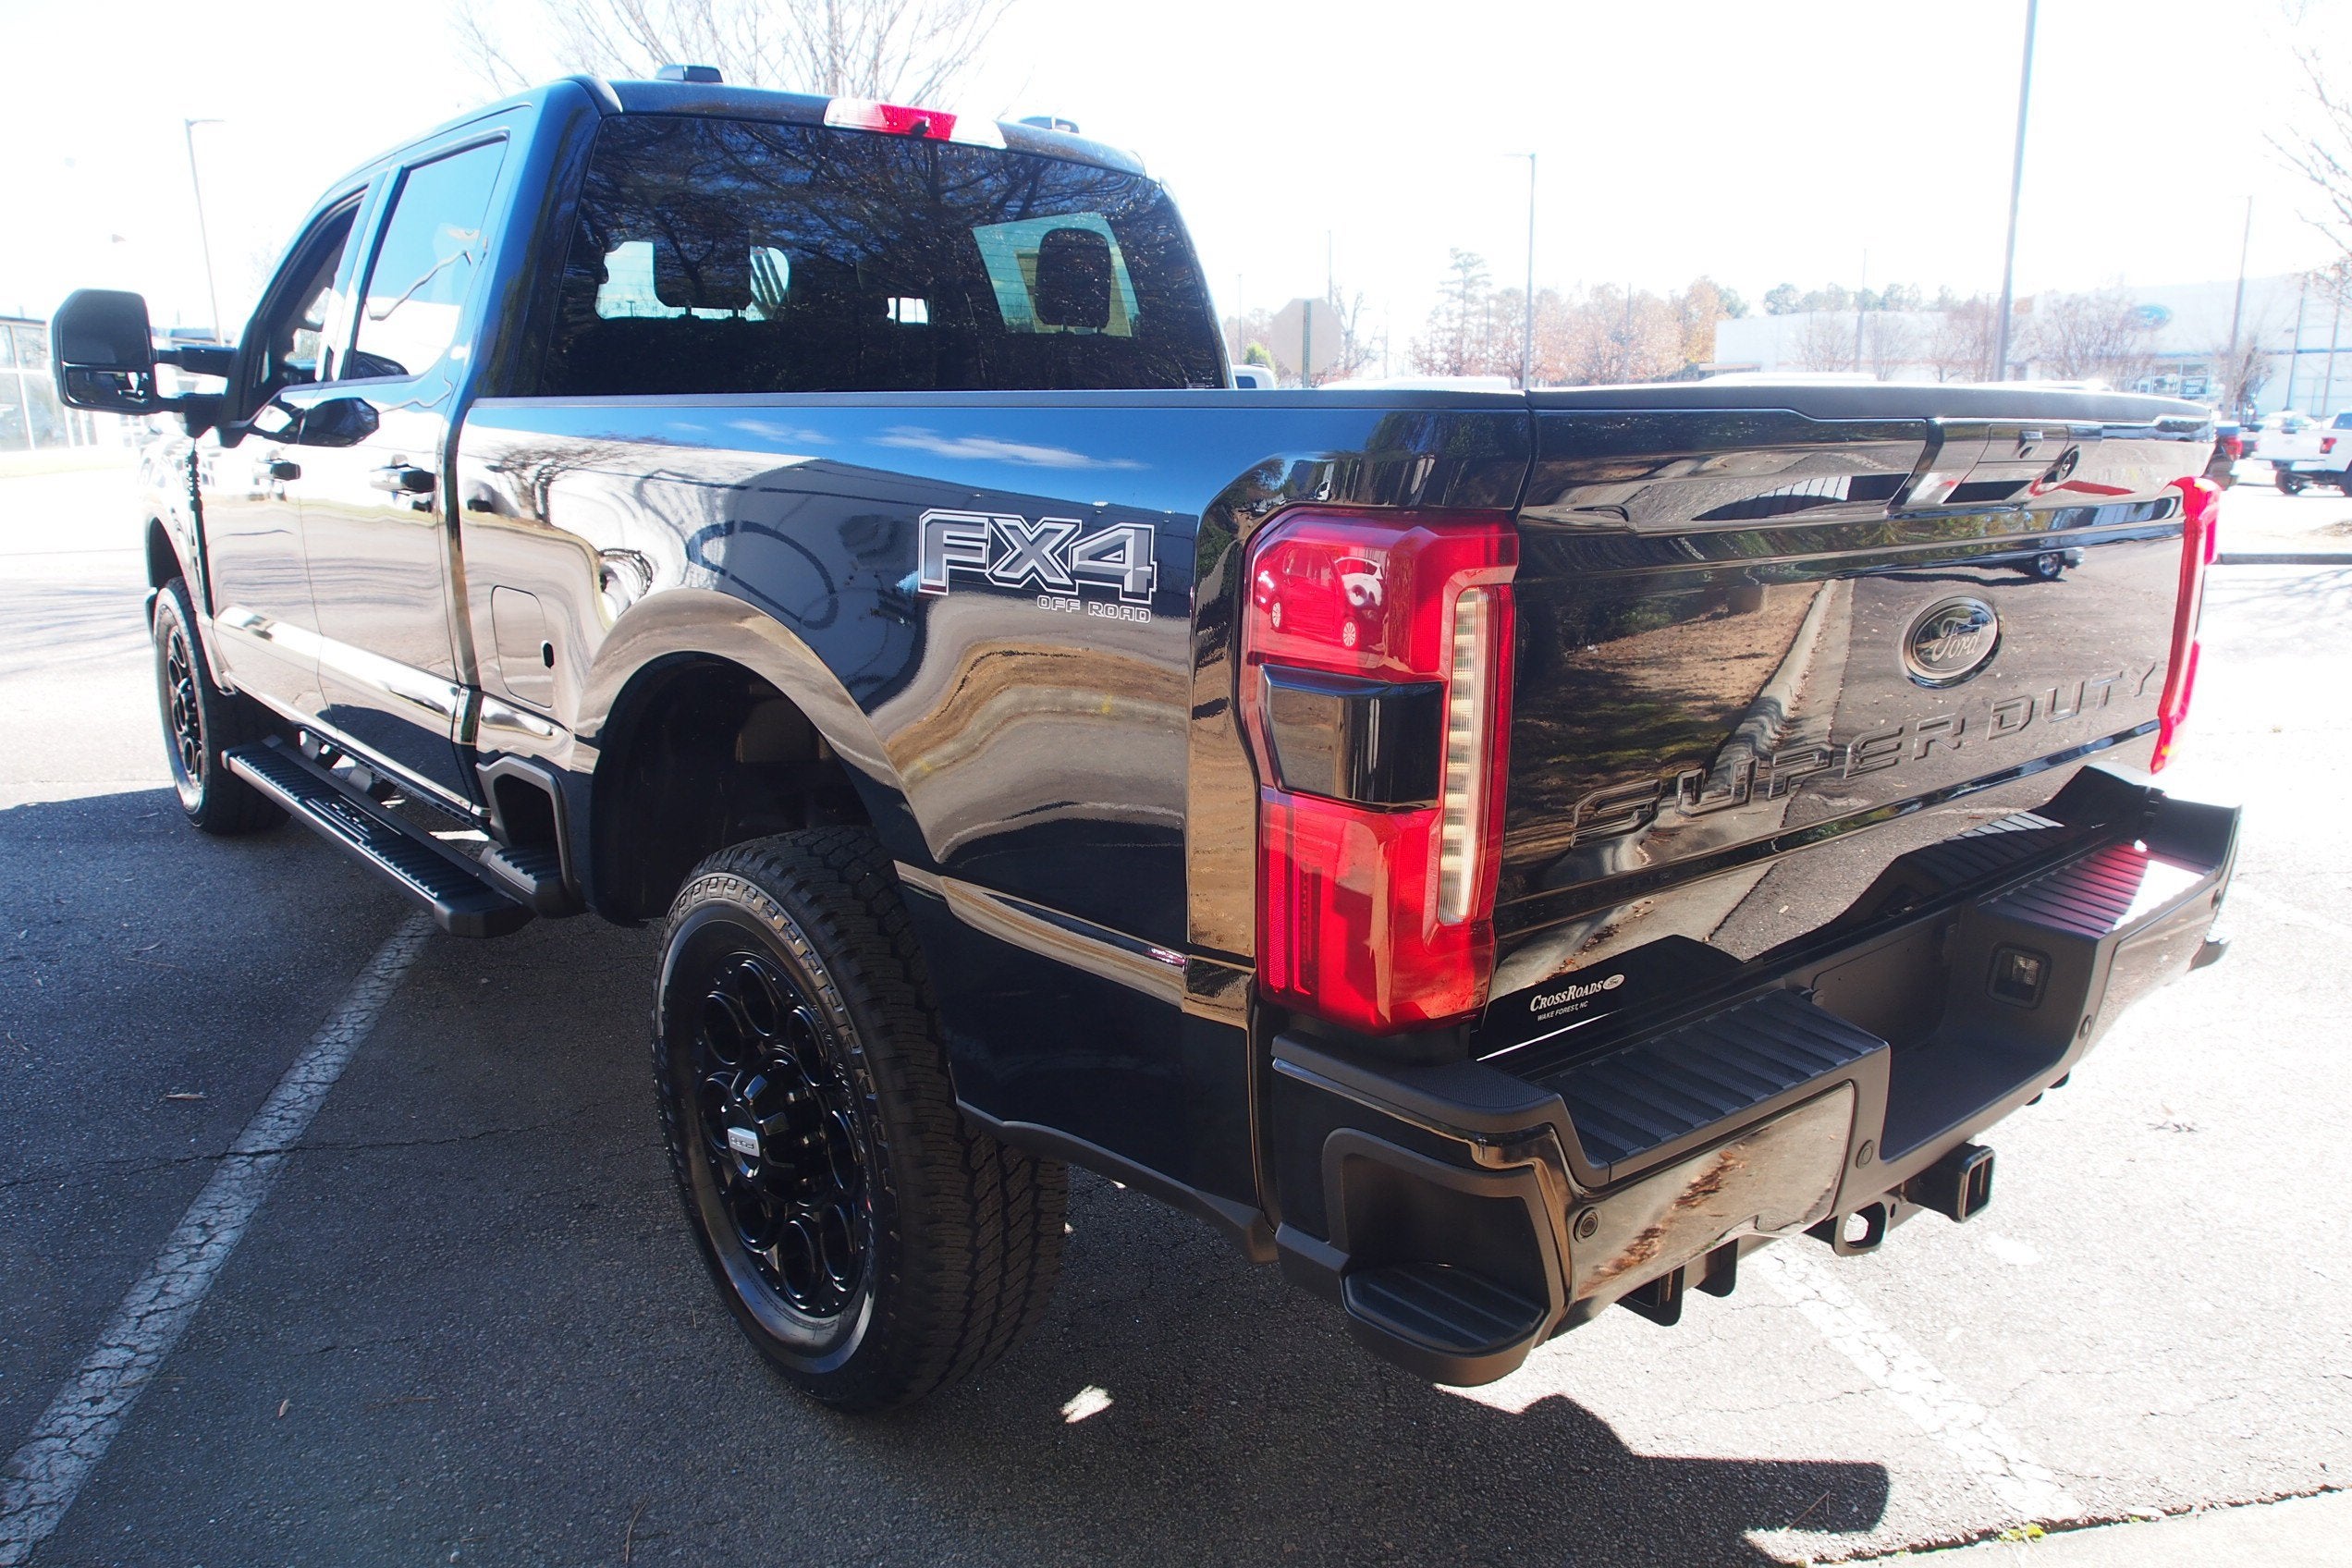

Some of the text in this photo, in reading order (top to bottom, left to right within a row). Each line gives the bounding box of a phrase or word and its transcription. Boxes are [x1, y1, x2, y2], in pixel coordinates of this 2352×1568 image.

[918, 508, 1157, 605] FX4
[1036, 594, 1151, 623] OFF ROAD
[1931, 616, 1983, 662] Ford
[1570, 662, 2157, 849] SUPER DUTY
[1537, 1011, 1554, 1022] WAKE
[1579, 1000, 1589, 1009] NC
